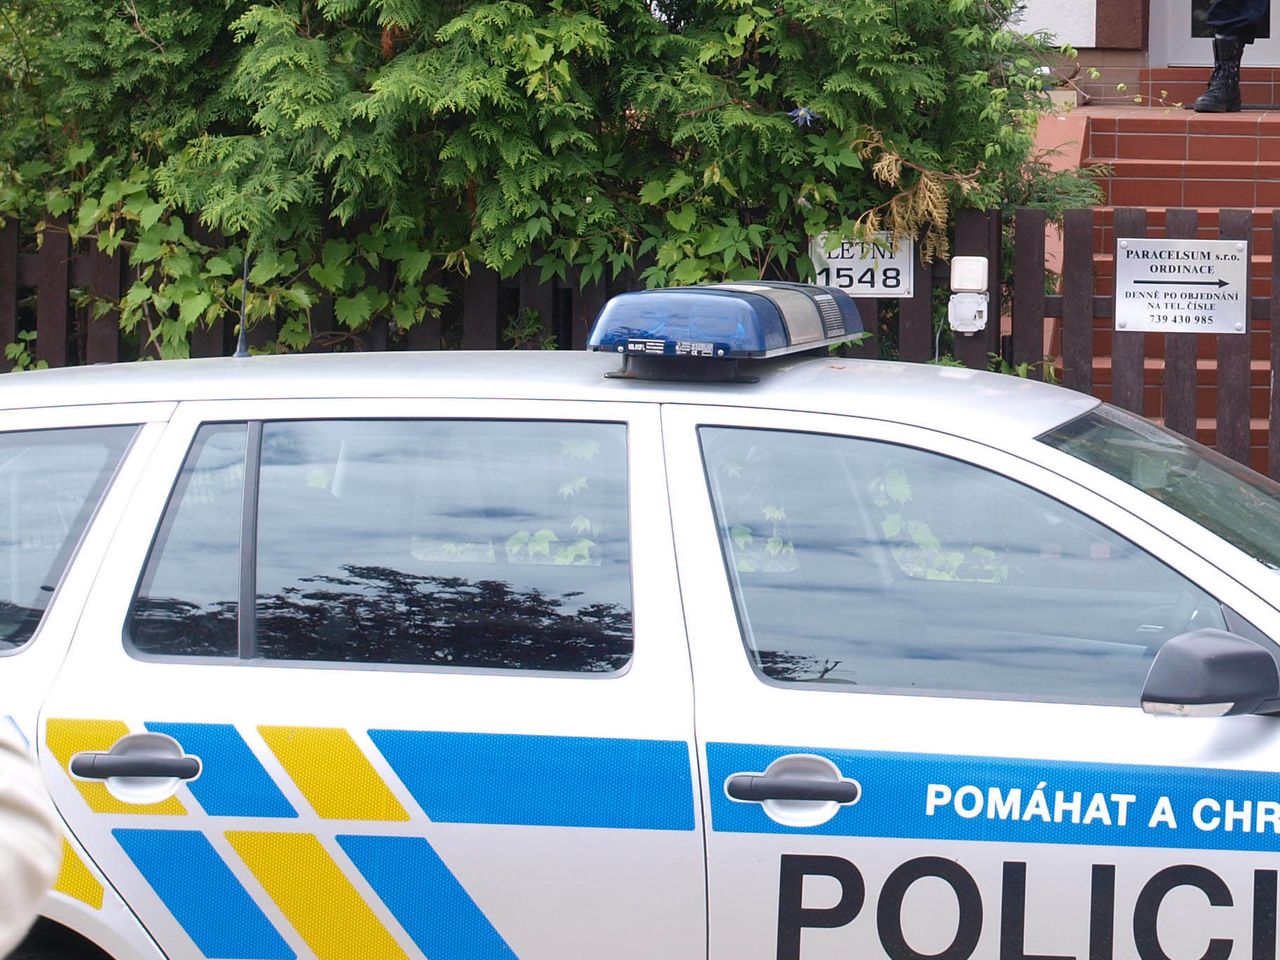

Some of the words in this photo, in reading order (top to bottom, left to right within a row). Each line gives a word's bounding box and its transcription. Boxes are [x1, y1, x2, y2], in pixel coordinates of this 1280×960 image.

[1126, 249, 1211, 260] PARACELSUM
[1215, 253, 1240, 261] s.r.o.
[1149, 264, 1215, 274] ORDINACE
[817, 267, 900, 288] 1548
[1125, 290, 1159, 299] DENNĚ
[1163, 292, 1177, 300] PO
[1180, 292, 1239, 301] OBJEDNÁNÍ
[1148, 302, 1161, 310] NA
[1187, 302, 1216, 311] ČÍSLE
[1149, 315, 1168, 324] 739
[1171, 315, 1191, 324] 430
[1194, 315, 1214, 325] 985
[925, 781, 1136, 827] POMÁHAT
[1148, 796, 1177, 829] A
